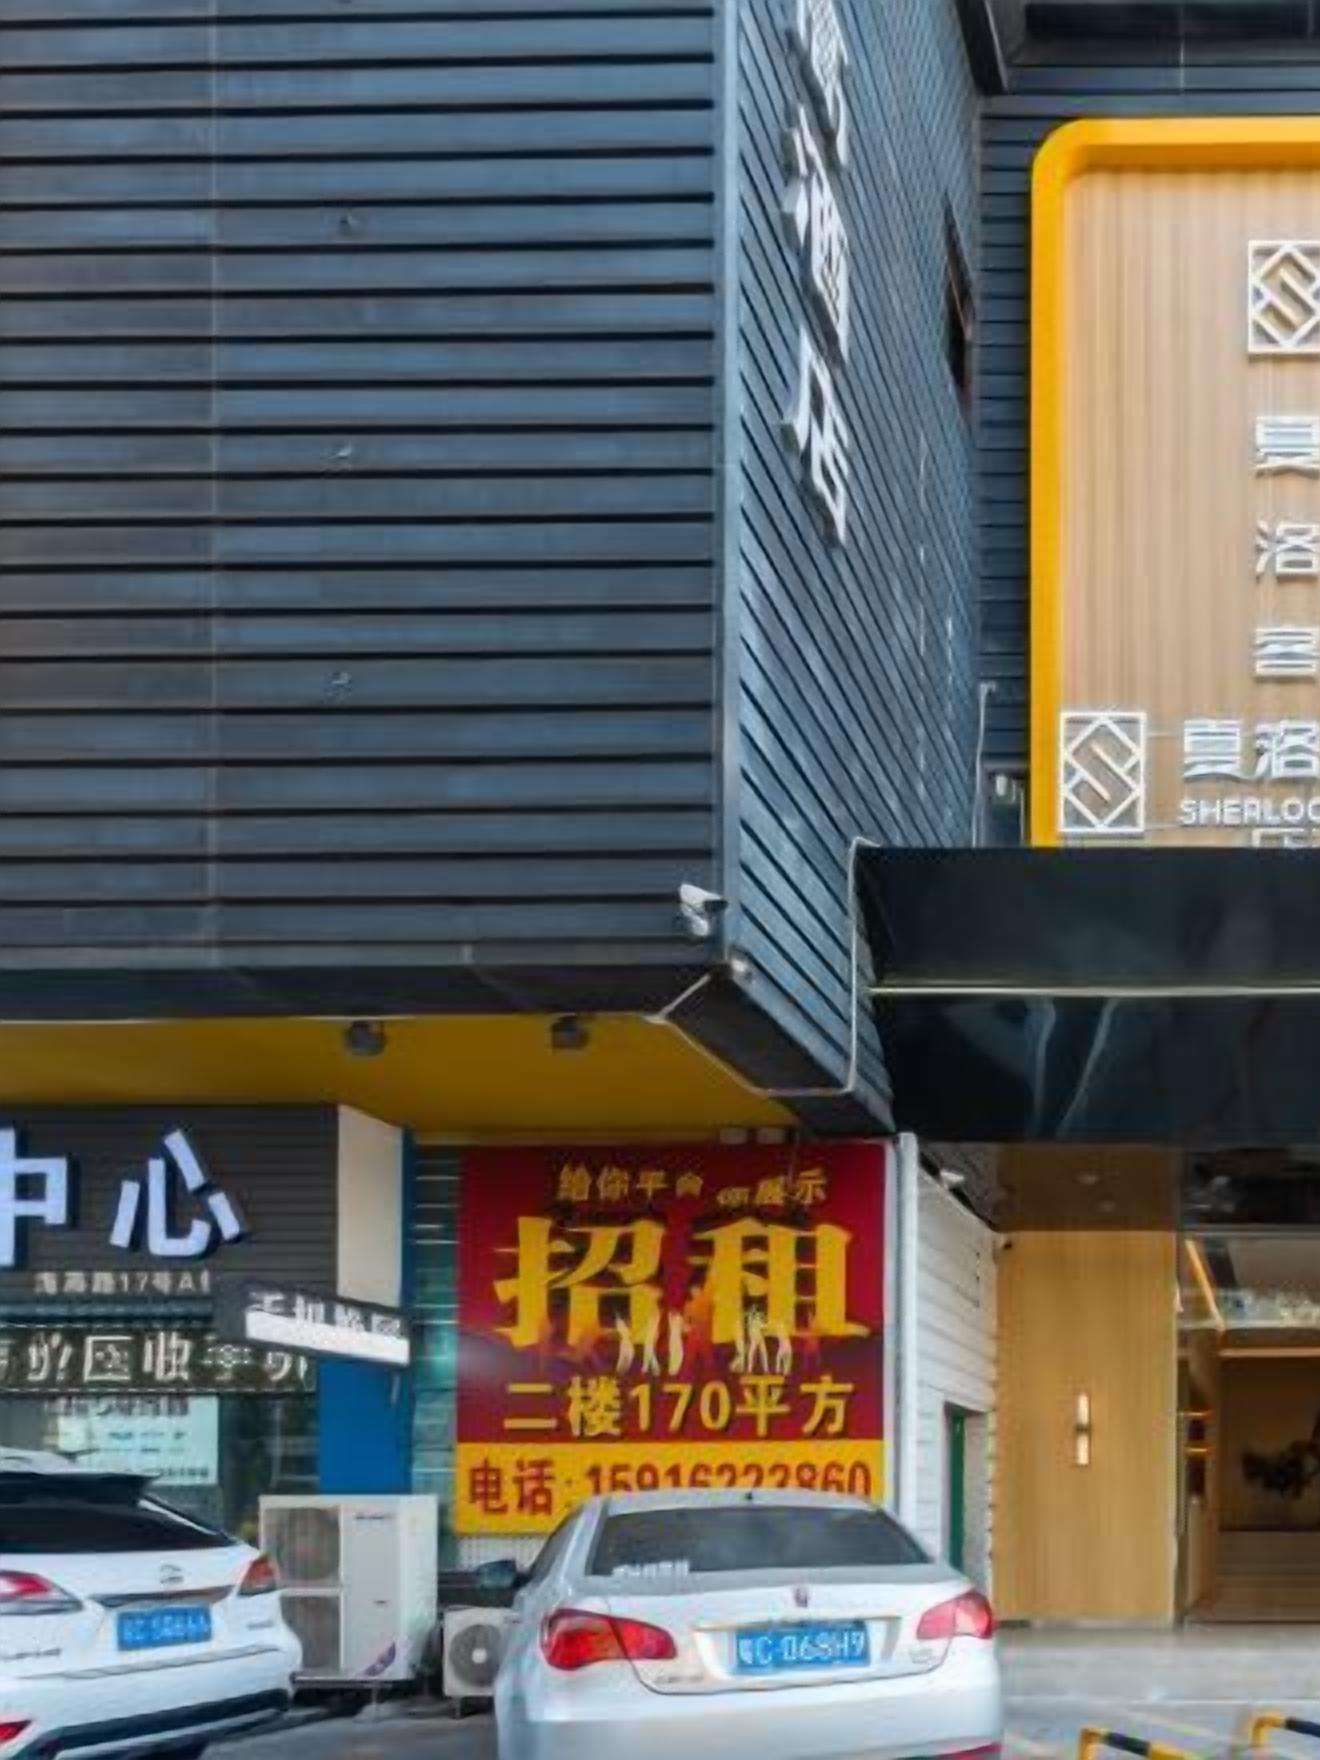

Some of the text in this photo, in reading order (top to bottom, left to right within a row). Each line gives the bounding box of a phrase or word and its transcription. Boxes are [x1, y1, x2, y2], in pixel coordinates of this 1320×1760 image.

[492, 1215, 871, 1350] 招租
[502, 1374, 854, 1438] 二楼170平方
